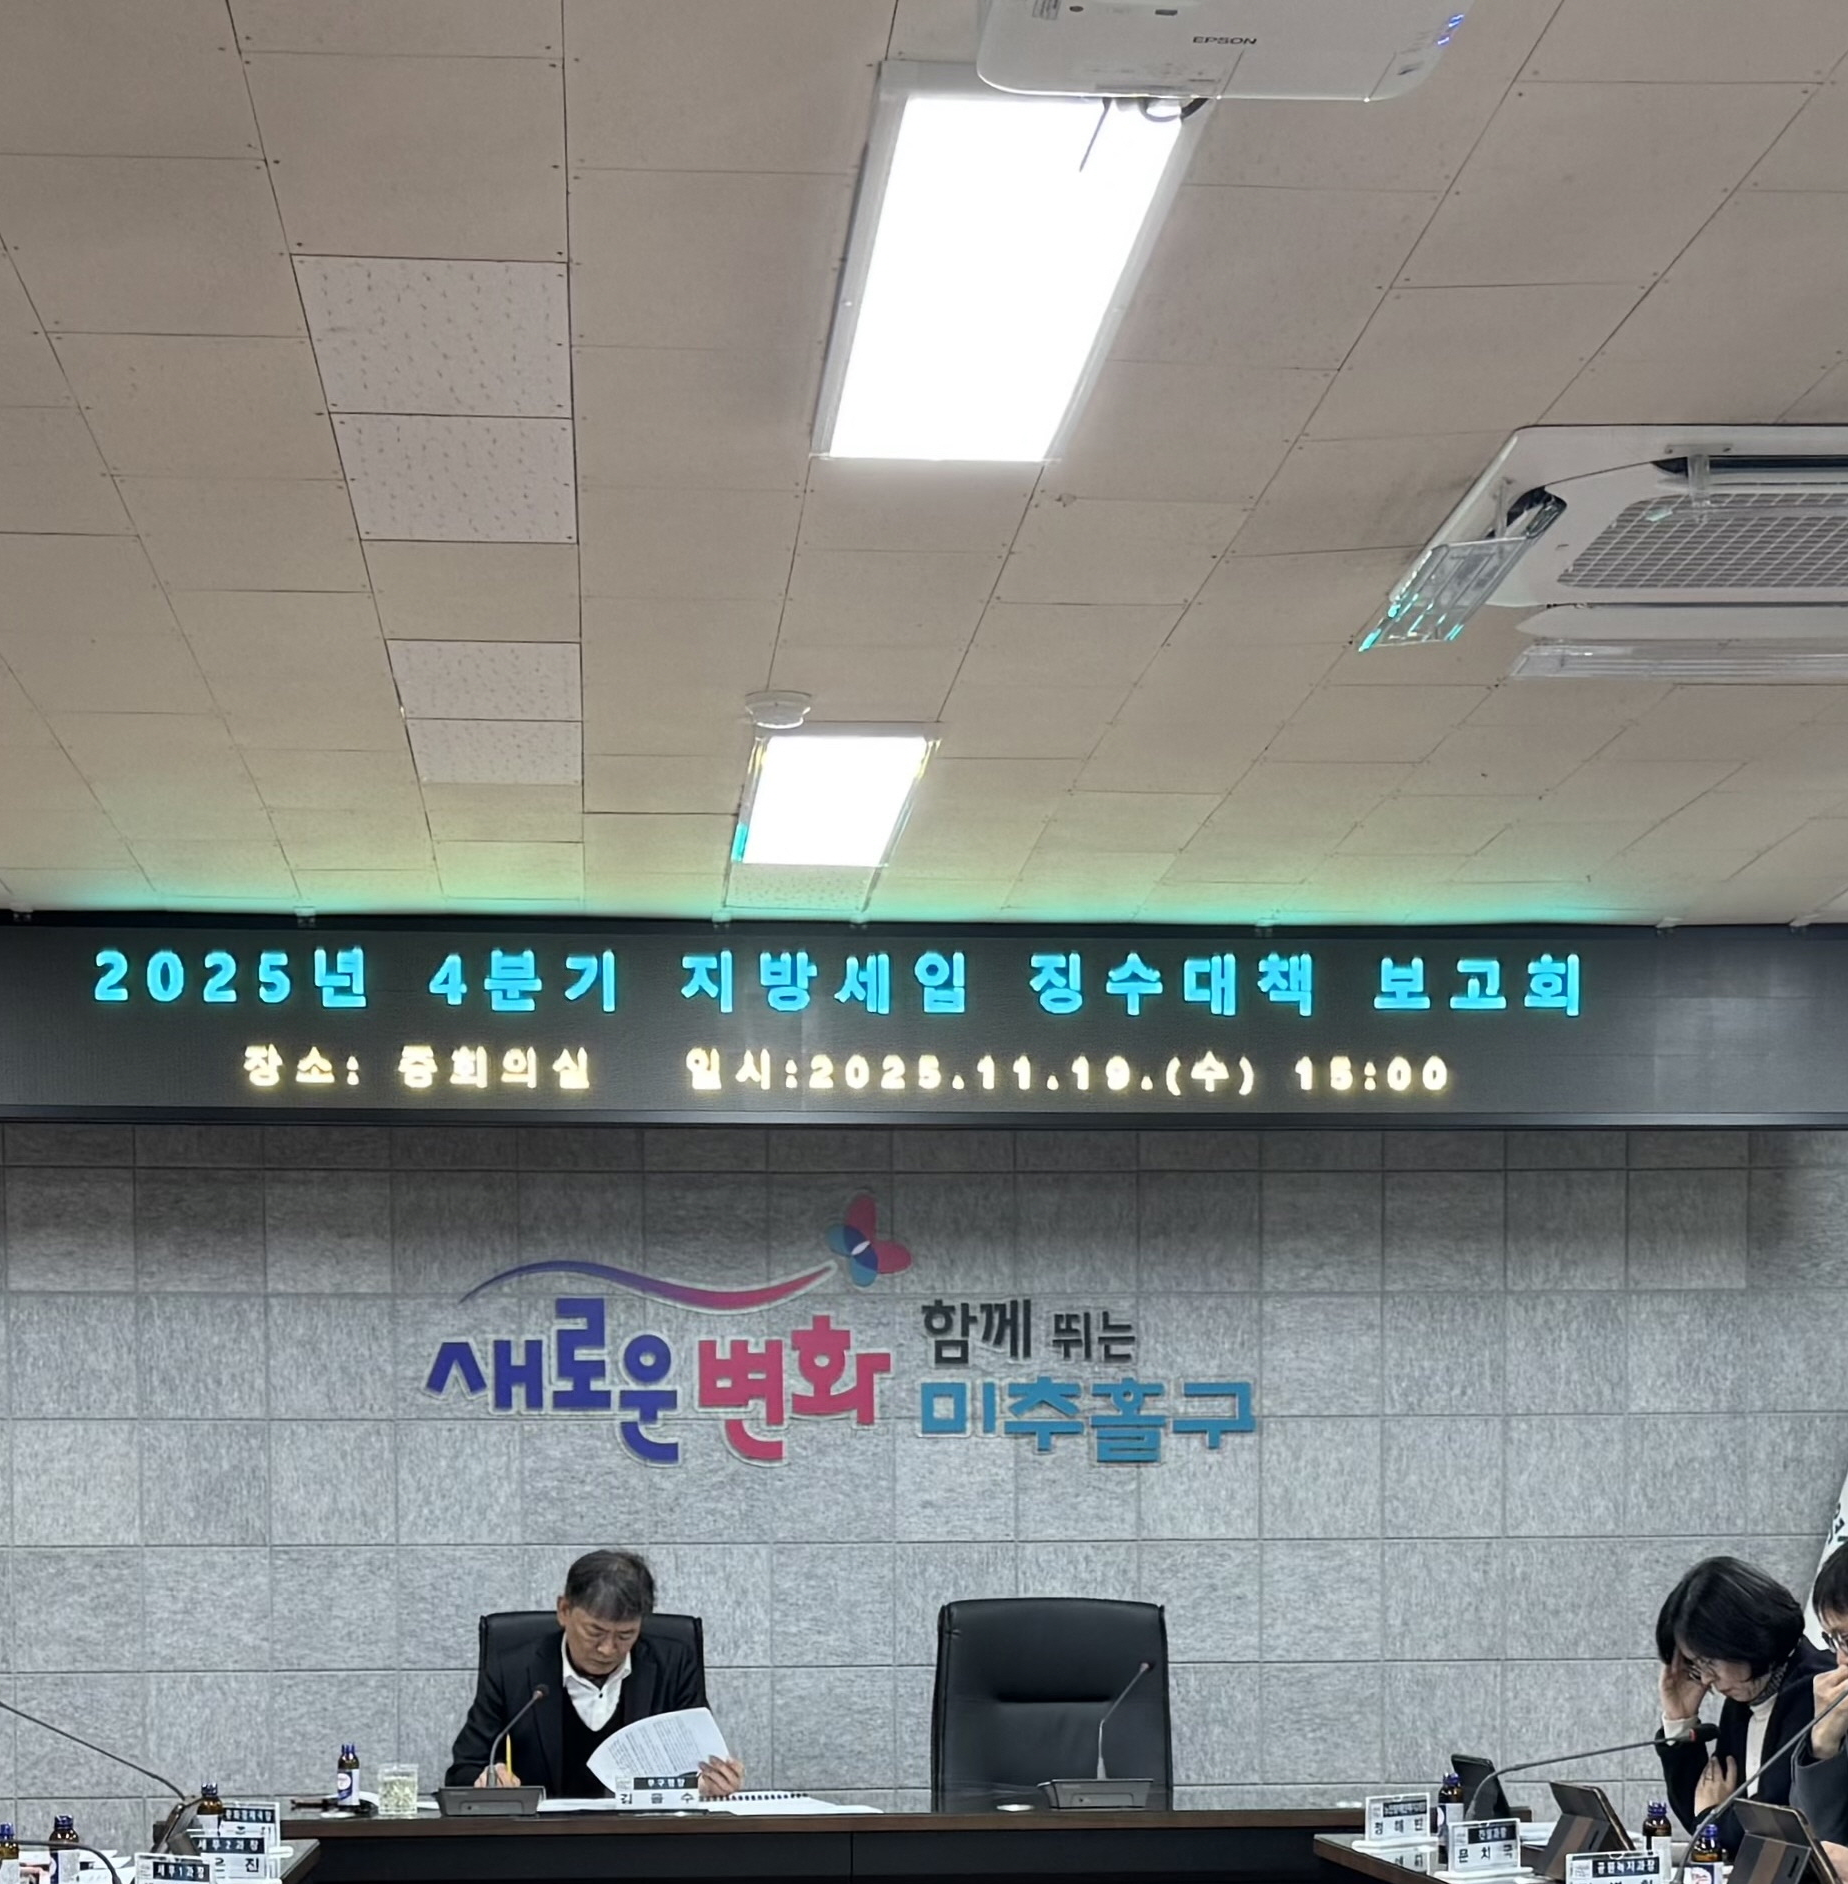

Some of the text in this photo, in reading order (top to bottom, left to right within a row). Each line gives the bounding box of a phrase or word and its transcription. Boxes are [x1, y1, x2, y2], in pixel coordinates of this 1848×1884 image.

[1193, 36, 1257, 45] EPSON
[93, 946, 1583, 1018] 2025년 4분기 지방세입 징수대책 보고회
[244, 1043, 360, 1087] 장소:
[398, 1045, 590, 1089] 중회의실
[921, 1298, 1137, 1365] 함께 뛰는
[427, 1299, 891, 1464] 새로운 변화
[920, 1376, 1256, 1464] 미추홀구
